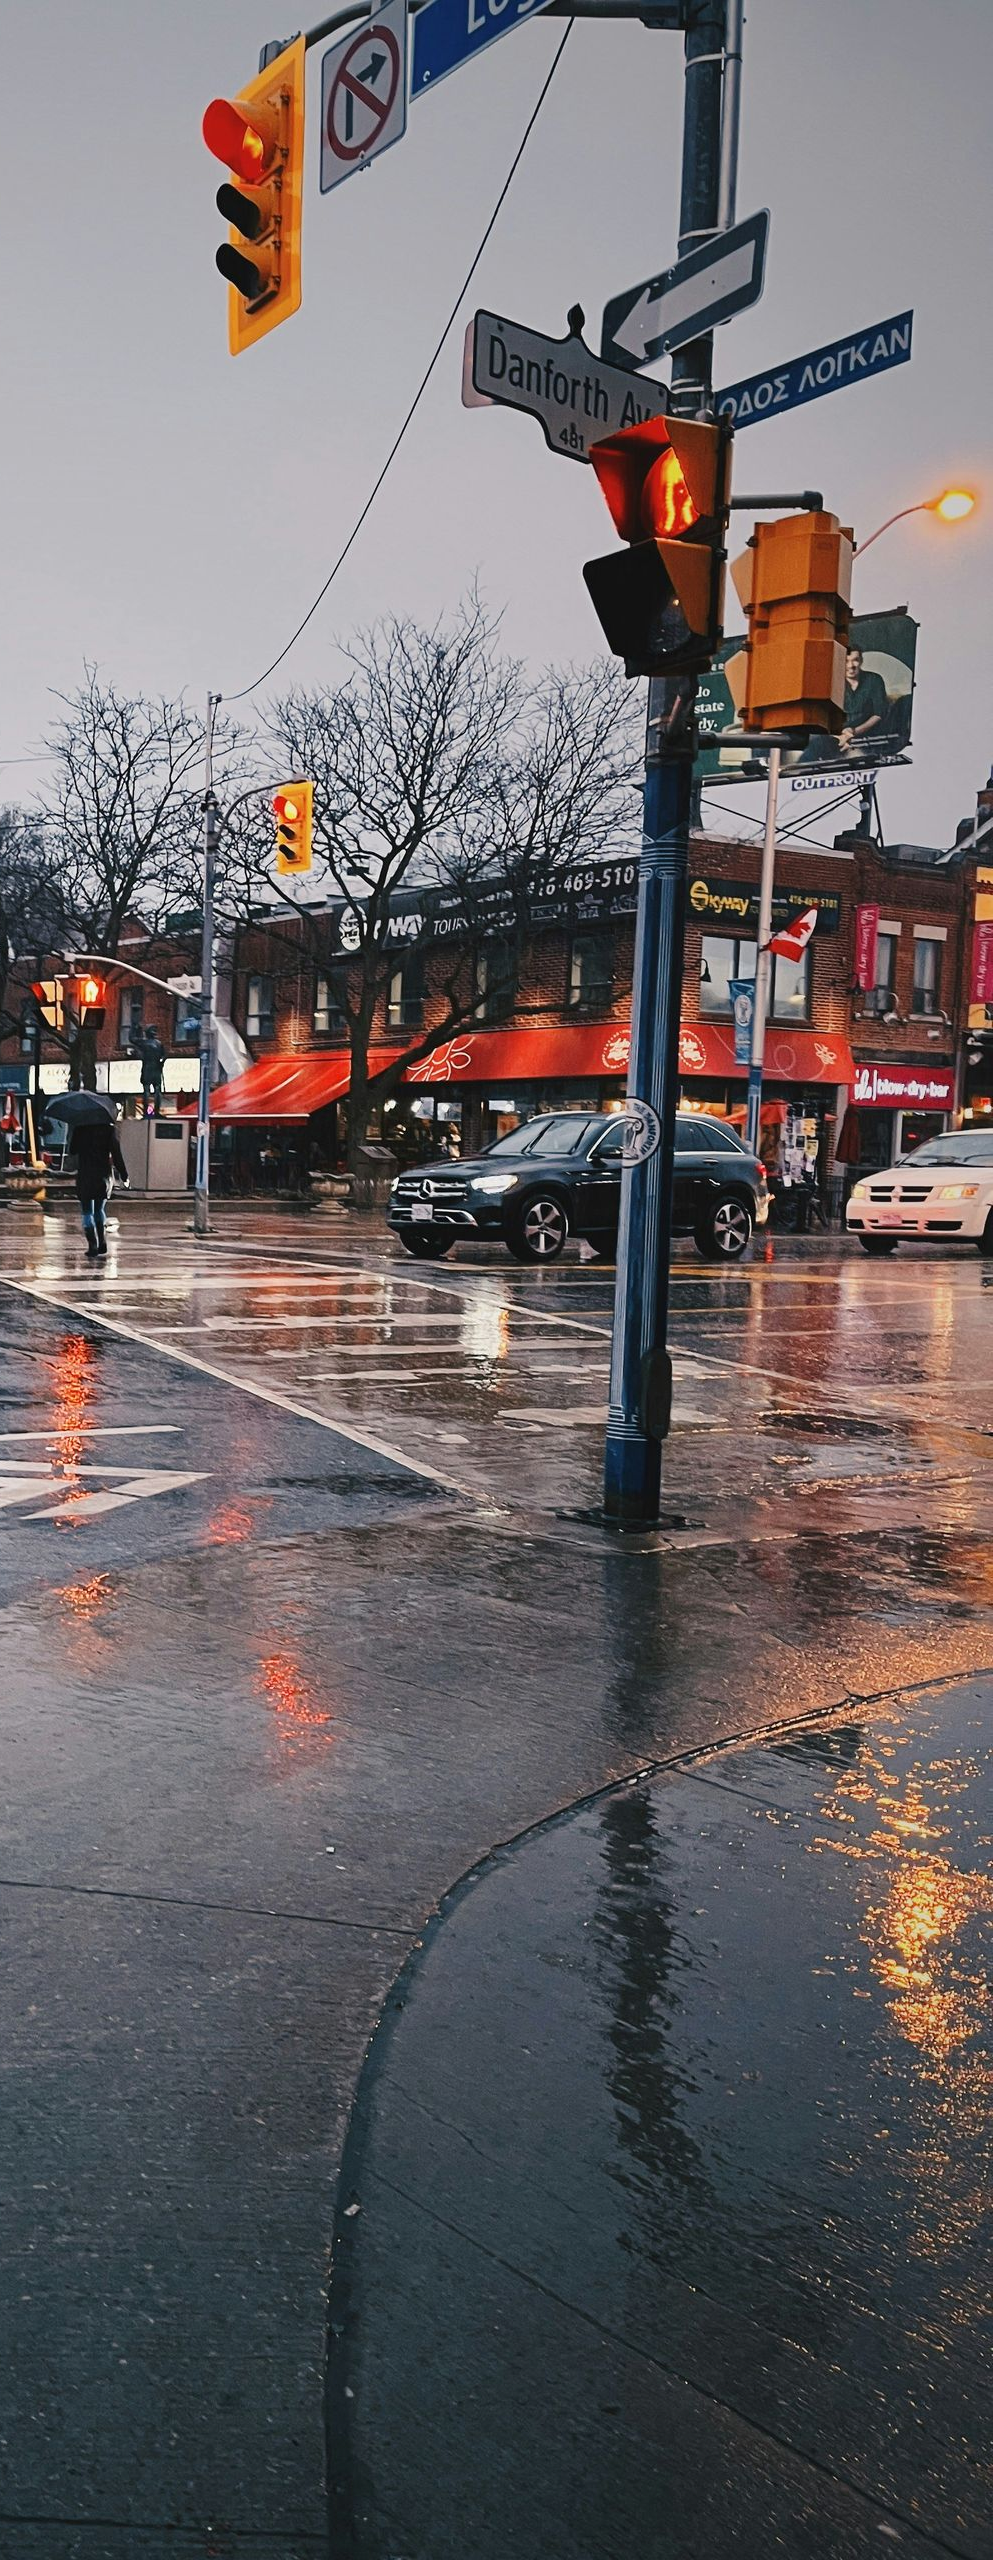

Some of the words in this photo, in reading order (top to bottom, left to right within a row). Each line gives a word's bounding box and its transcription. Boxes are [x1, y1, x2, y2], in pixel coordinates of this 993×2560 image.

[489, 334, 608, 422] Danforth
[798, 323, 910, 393] ΛΟΓΚΑΝ
[559, 428, 584, 452] 481
[793, 770, 876, 791] OUTFRONT
